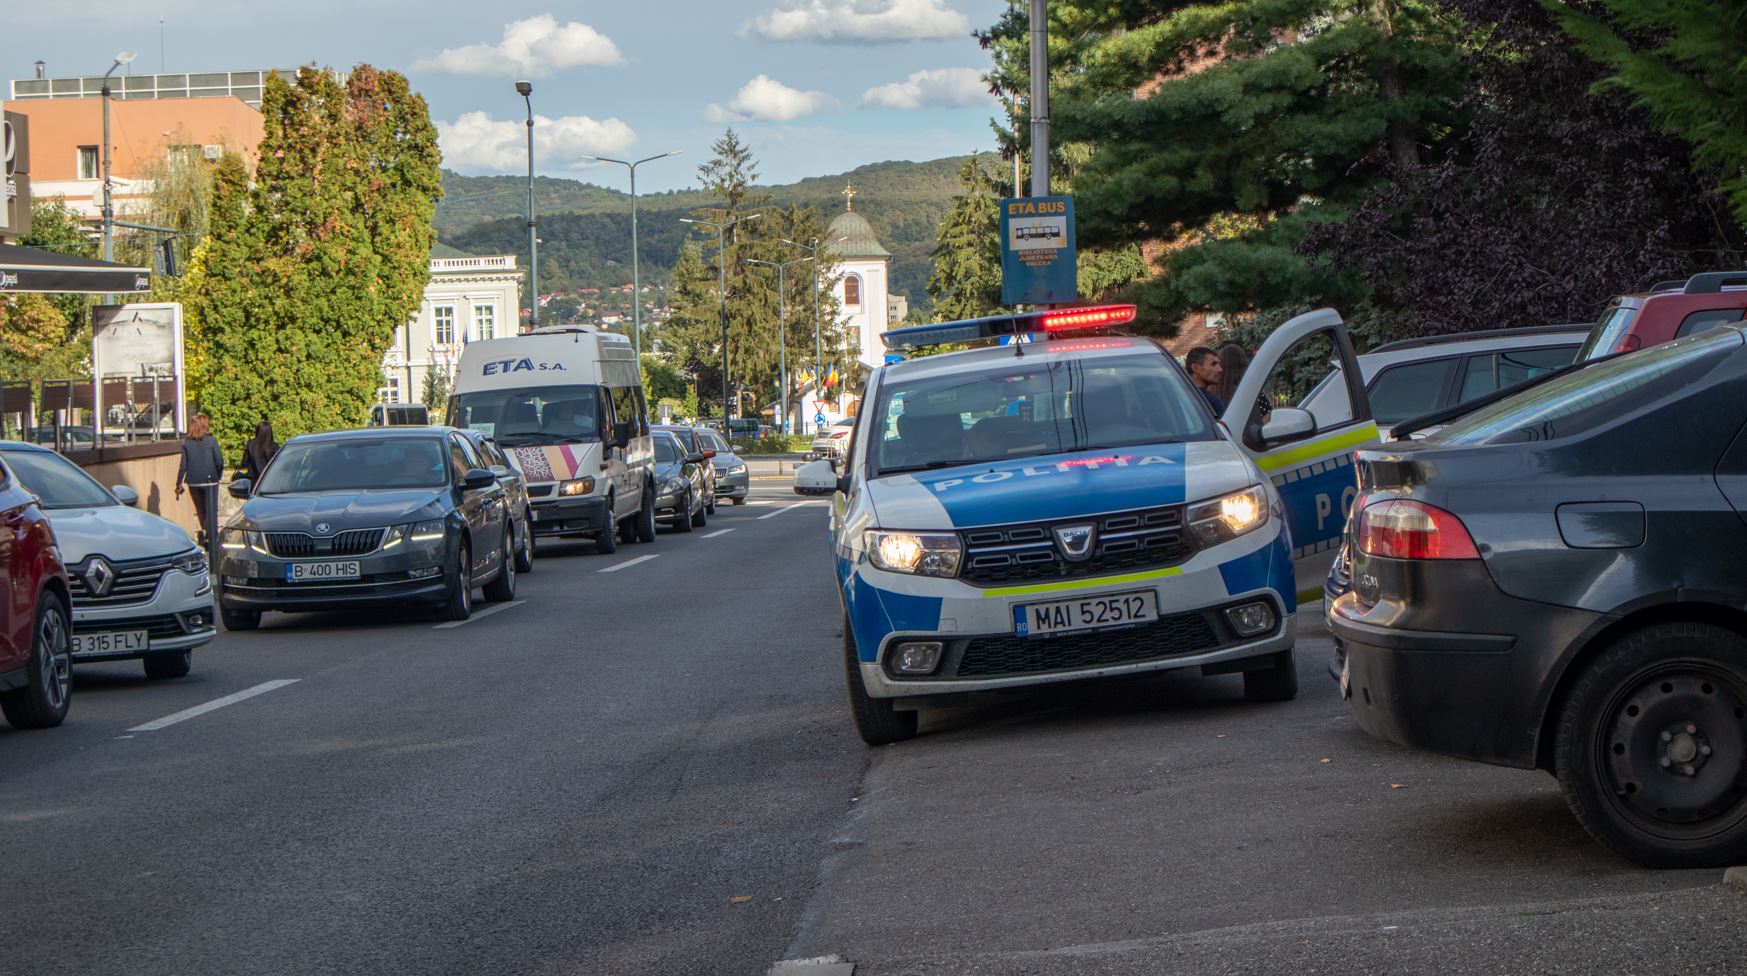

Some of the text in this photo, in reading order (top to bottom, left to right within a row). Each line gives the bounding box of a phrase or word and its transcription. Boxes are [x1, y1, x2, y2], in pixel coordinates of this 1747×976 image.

[1008, 201, 1065, 215] ETA BUS
[482, 357, 567, 376] ETA S.A.
[1063, 530, 1088, 538] DACIA
[294, 565, 304, 578] B
[309, 564, 332, 577] 400
[335, 562, 357, 576] HIS
[1035, 596, 1146, 630] MAI 52512
[1016, 621, 1028, 633] RO
[72, 637, 82, 653] B
[87, 634, 110, 652] 315
[114, 631, 144, 650] FLY
